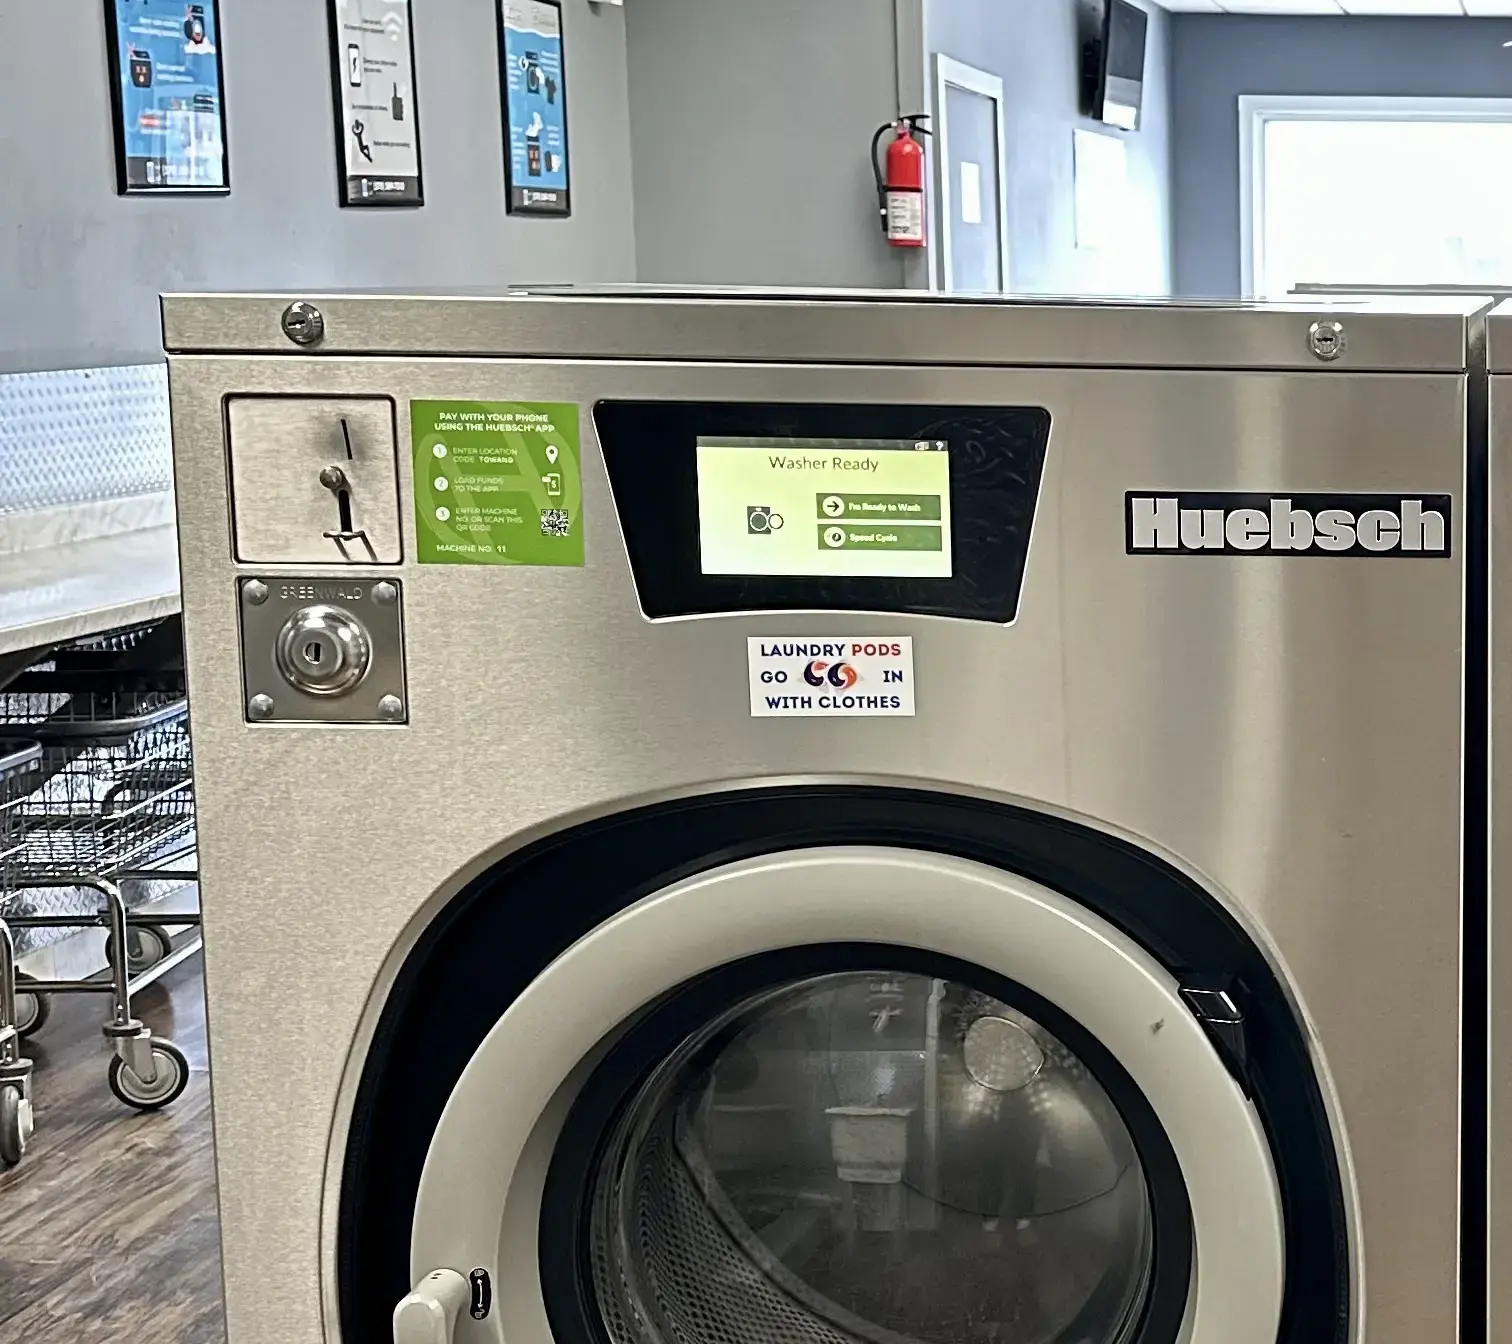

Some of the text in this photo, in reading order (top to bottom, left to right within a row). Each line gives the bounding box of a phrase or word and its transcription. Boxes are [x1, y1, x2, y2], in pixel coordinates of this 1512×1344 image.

[440, 412, 549, 422] PAY WITH YOUR PHONE
[536, 424, 554, 432] APP
[768, 456, 879, 472] Washer Ready
[454, 476, 475, 484] LOAD
[482, 508, 518, 516] MACHINE
[484, 516, 504, 524] SCAN
[506, 516, 523, 524] THIS
[1131, 497, 1445, 552] Huebsch
[469, 524, 491, 532] CODE
[436, 544, 476, 552] MACHINE
[280, 586, 363, 600] GREENWALD
[760, 644, 901, 656] LAUNDRY PODS
[760, 670, 903, 683] GO IN
[765, 696, 900, 708] WITH CLOTHES
